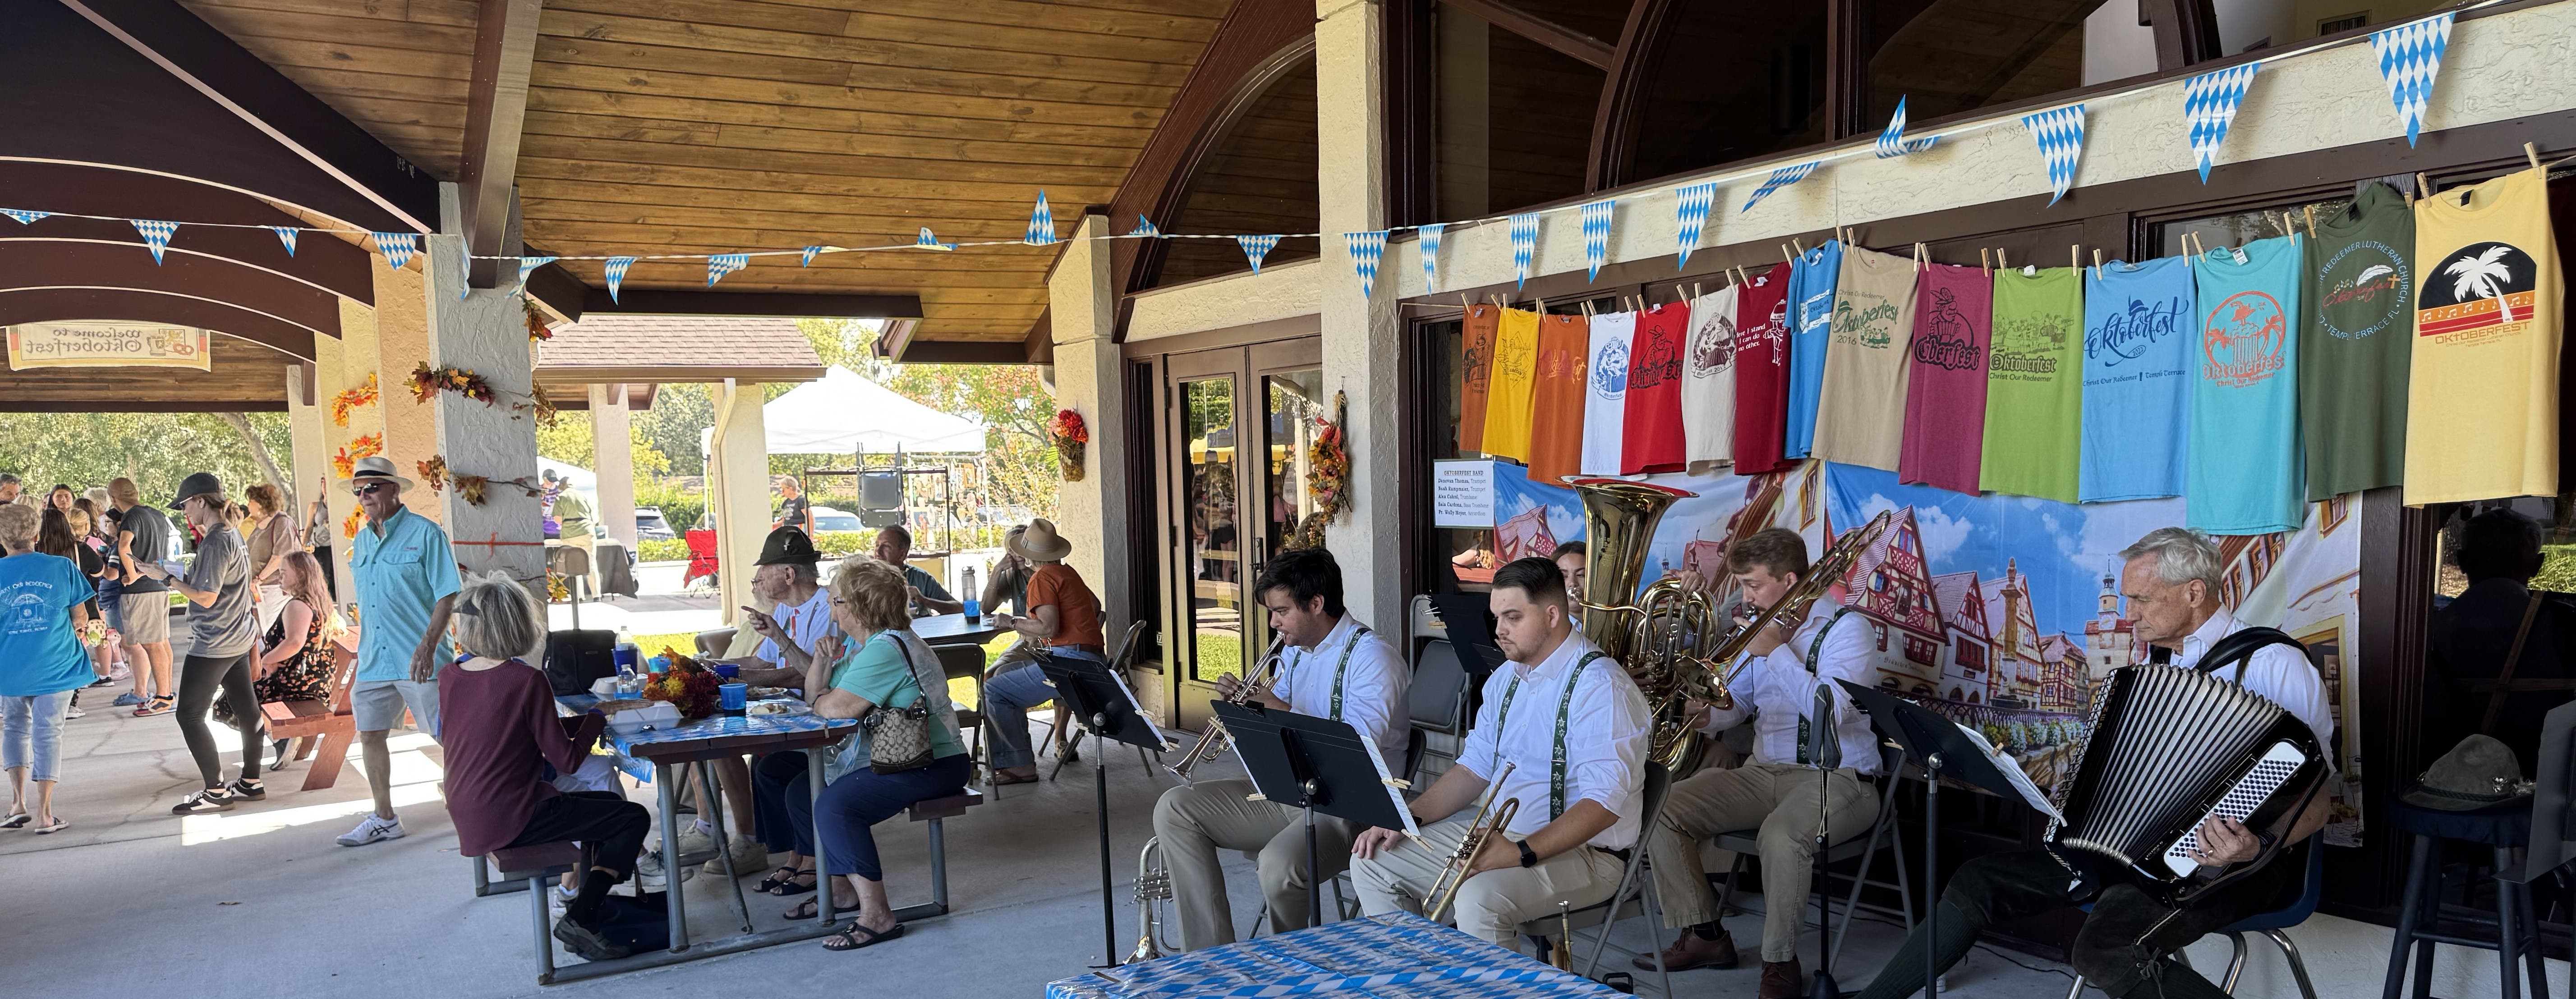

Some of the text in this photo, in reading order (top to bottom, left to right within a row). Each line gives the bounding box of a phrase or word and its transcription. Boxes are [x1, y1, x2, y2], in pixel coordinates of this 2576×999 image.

[2323, 242, 2360, 274] REDEEMER
[2362, 240, 2403, 266] LUTHERAN
[2397, 266, 2409, 302] CHURCH
[1751, 323, 1765, 332] stand
[2084, 296, 2189, 363] Oktoberfest
[2327, 309, 2399, 340] TEMPL ERRACE FL
[1837, 335, 1857, 345] 2016
[1989, 353, 2057, 373] Oktoberfest
[2113, 375, 2137, 383] Redeemer
[2145, 370, 2162, 378] Temple
[2097, 680, 2119, 730] HOHNER
